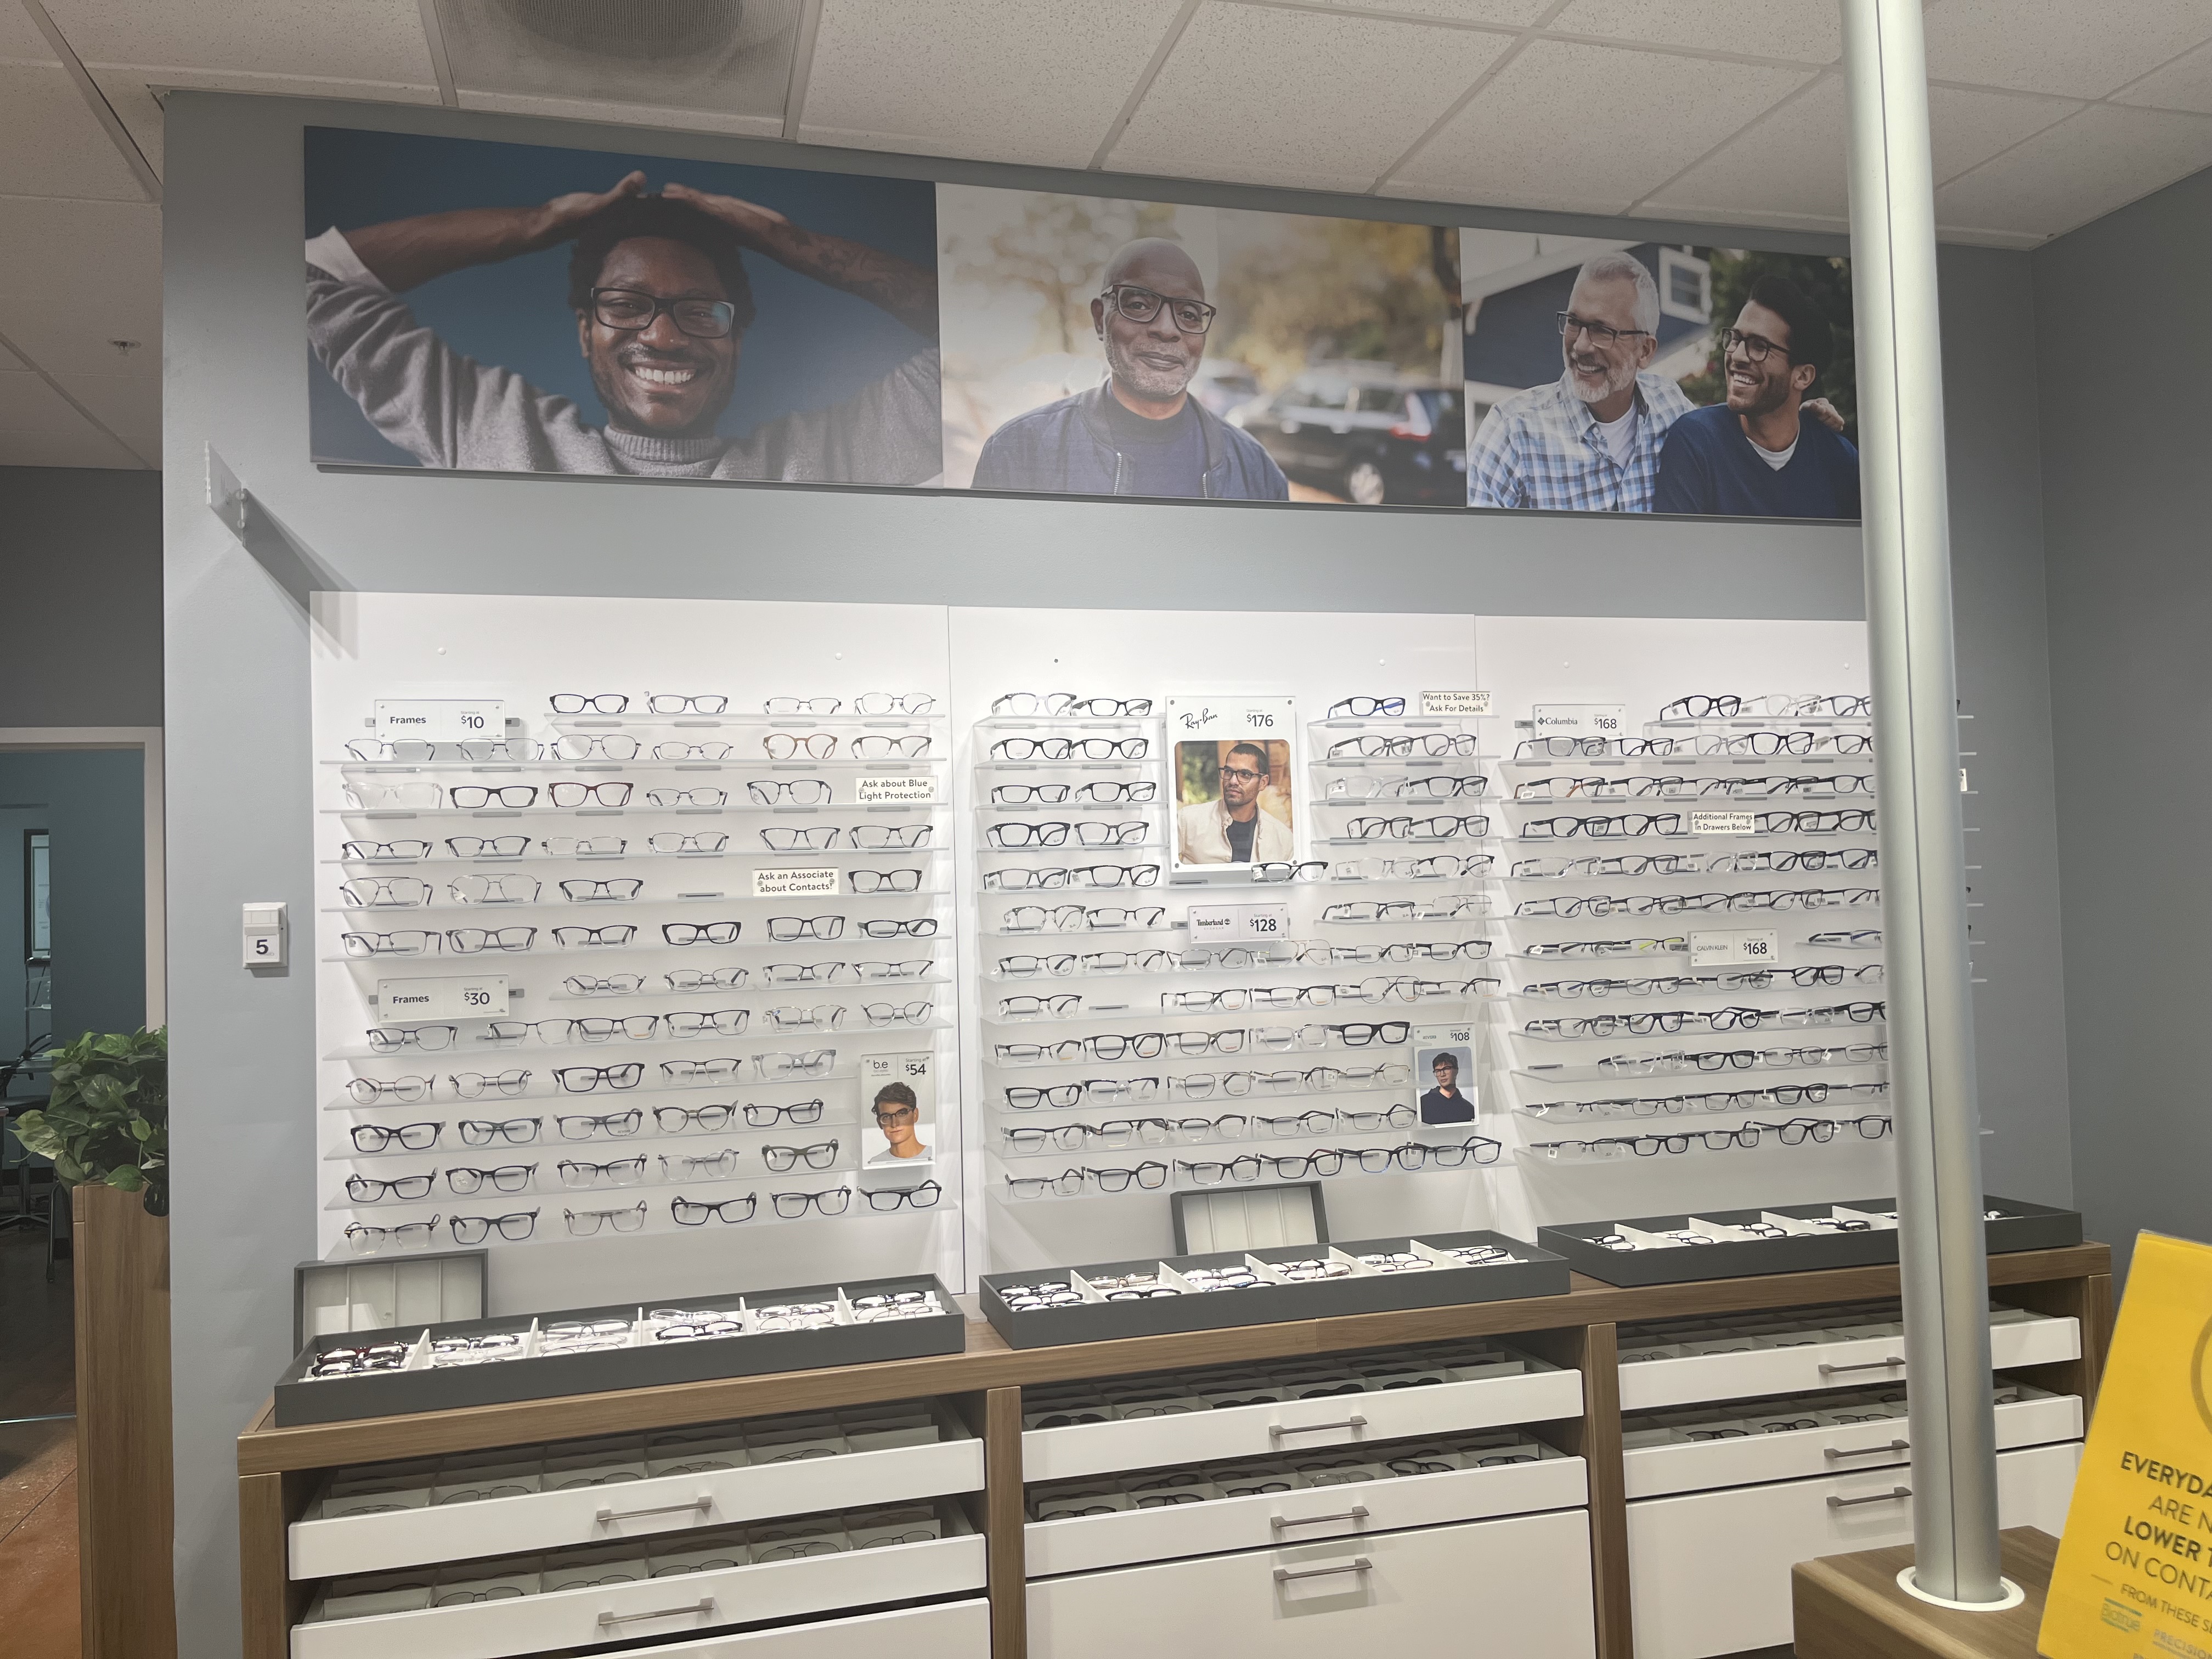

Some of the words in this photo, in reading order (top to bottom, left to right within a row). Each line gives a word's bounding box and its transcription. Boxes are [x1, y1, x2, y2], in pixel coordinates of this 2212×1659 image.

[390, 716, 427, 724] Frames
[461, 715, 484, 729] $10
[1246, 713, 1273, 727] $176
[1545, 717, 1578, 725] Columbia
[1594, 718, 1617, 729] $168
[862, 780, 878, 788] Ask
[909, 779, 928, 787] Blue
[859, 792, 882, 802] Light
[885, 791, 931, 799] Protection
[758, 872, 775, 881] Ask
[791, 870, 834, 879] Associate
[760, 884, 787, 893] about
[789, 883, 832, 891] Contacts!
[1250, 918, 1277, 932] $128
[256, 939, 269, 955] 5
[1743, 942, 1767, 955] $168
[393, 996, 430, 1004] Frames
[464, 992, 490, 1005] $30
[1450, 1032, 1470, 1041] $108
[905, 1063, 927, 1076] $54
[2148, 1494, 2194, 1526] ARE
[2124, 1515, 2201, 1562] LOWER
[2106, 1541, 2141, 1570] ON
[2120, 1583, 2157, 1609] FROM
[2160, 1600, 2200, 1628] THESE
